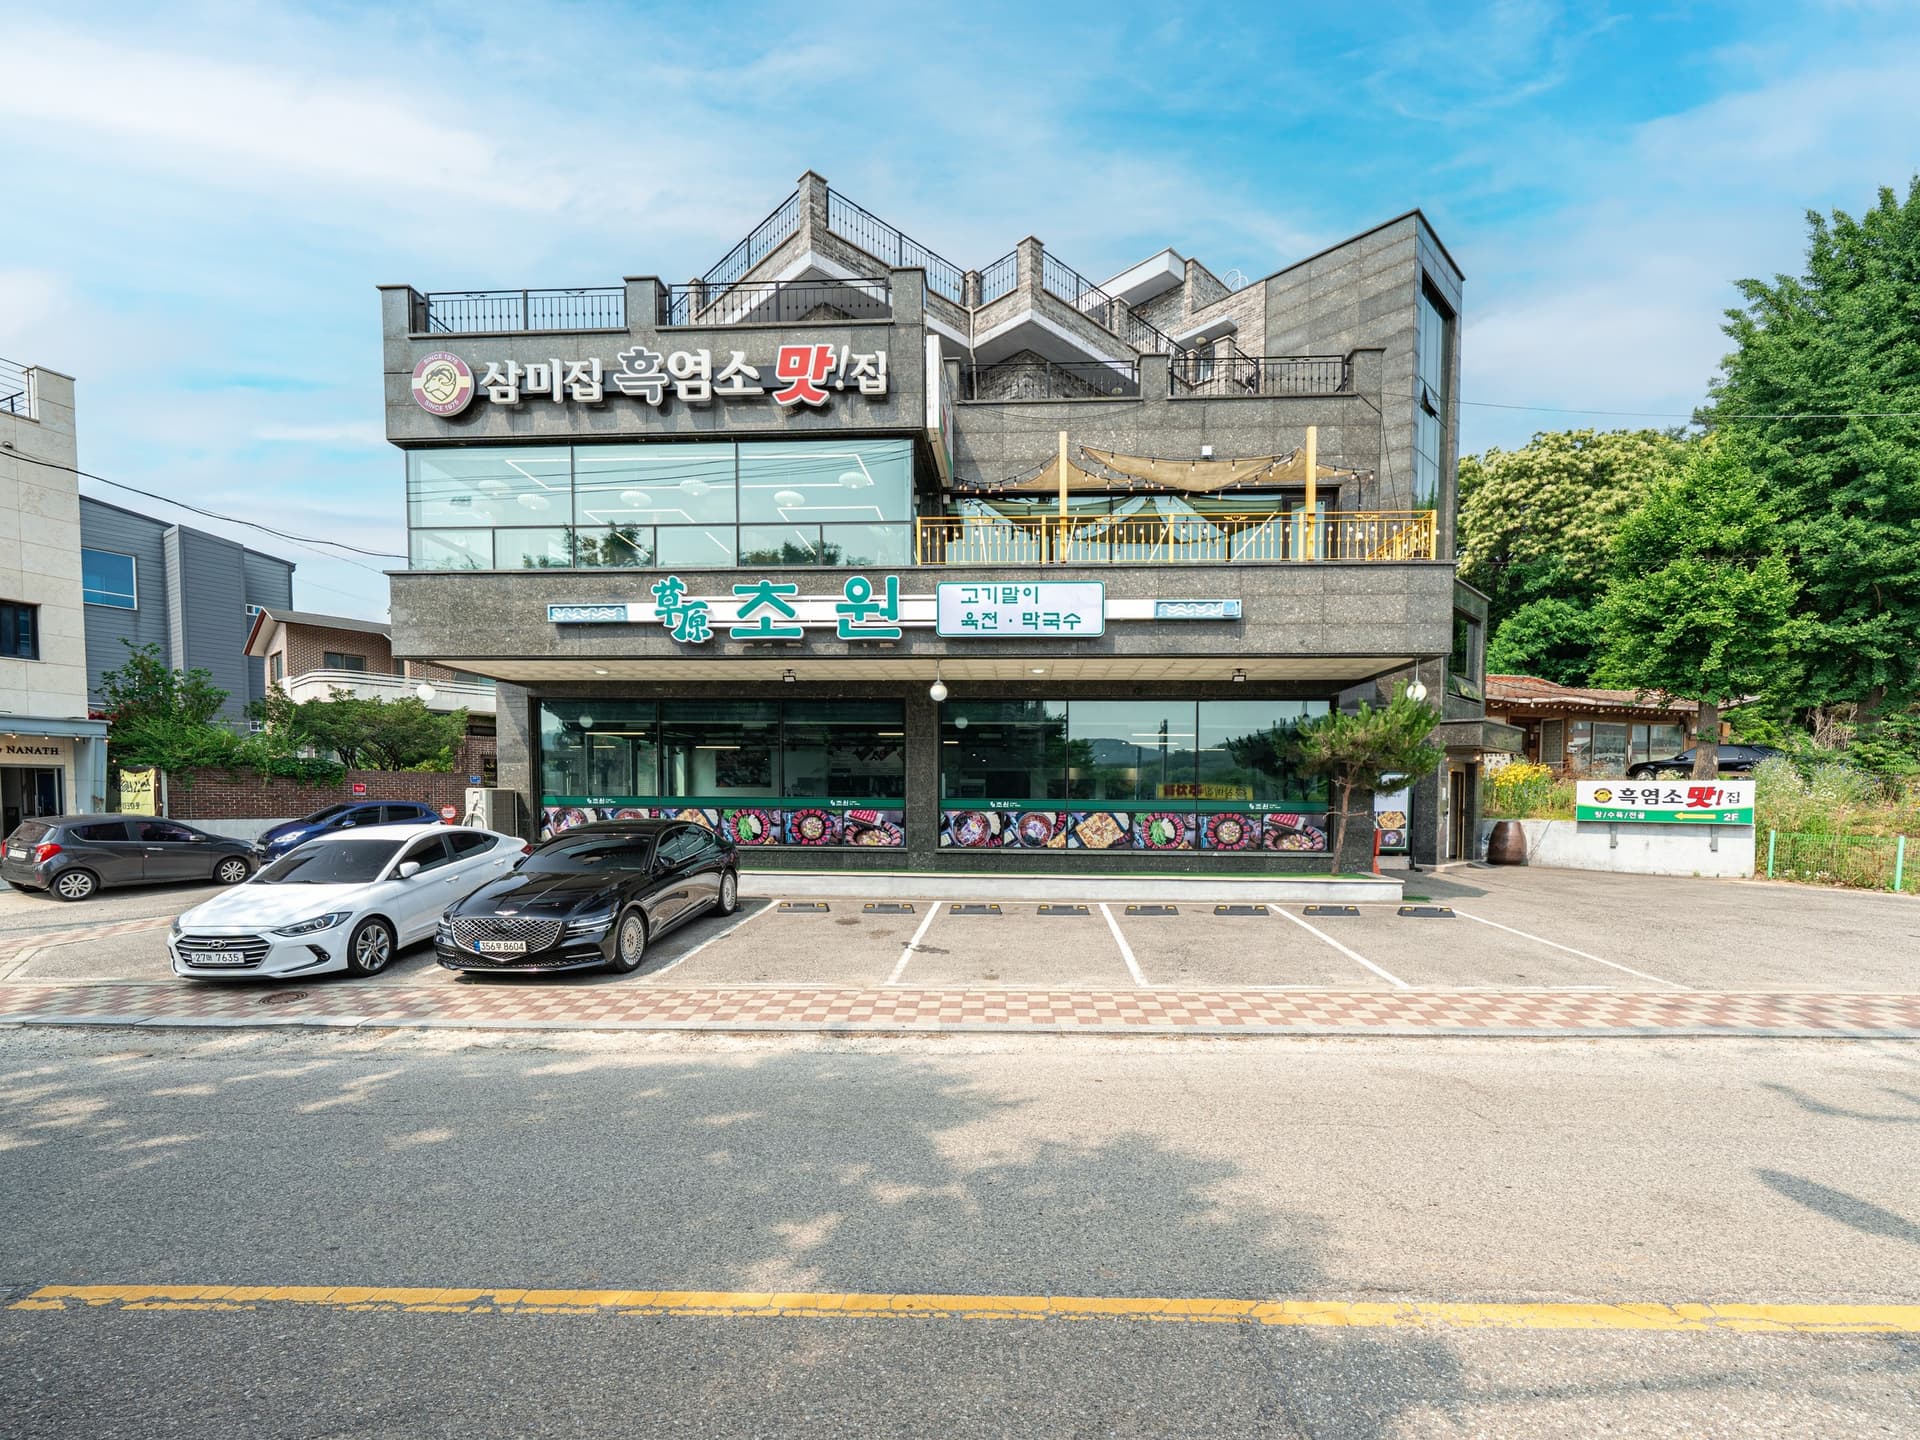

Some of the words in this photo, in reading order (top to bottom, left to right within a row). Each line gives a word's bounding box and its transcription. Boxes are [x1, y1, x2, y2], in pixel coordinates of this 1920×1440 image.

[480, 357, 603, 405] 삼미집
[613, 346, 765, 407] 흑염소
[772, 344, 888, 407] 맛!집
[960, 586, 1039, 605] 고기말이
[651, 576, 713, 642] 草原
[730, 576, 902, 640] 초원
[960, 611, 998, 631] 육전
[1022, 611, 1081, 631] 막국수
[6, 745, 59, 755] NANATH
[1618, 787, 1684, 805] 흑염소
[1723, 812, 1739, 822] 2F
[503, 942, 524, 951] 8604
[215, 953, 240, 962] 7635
